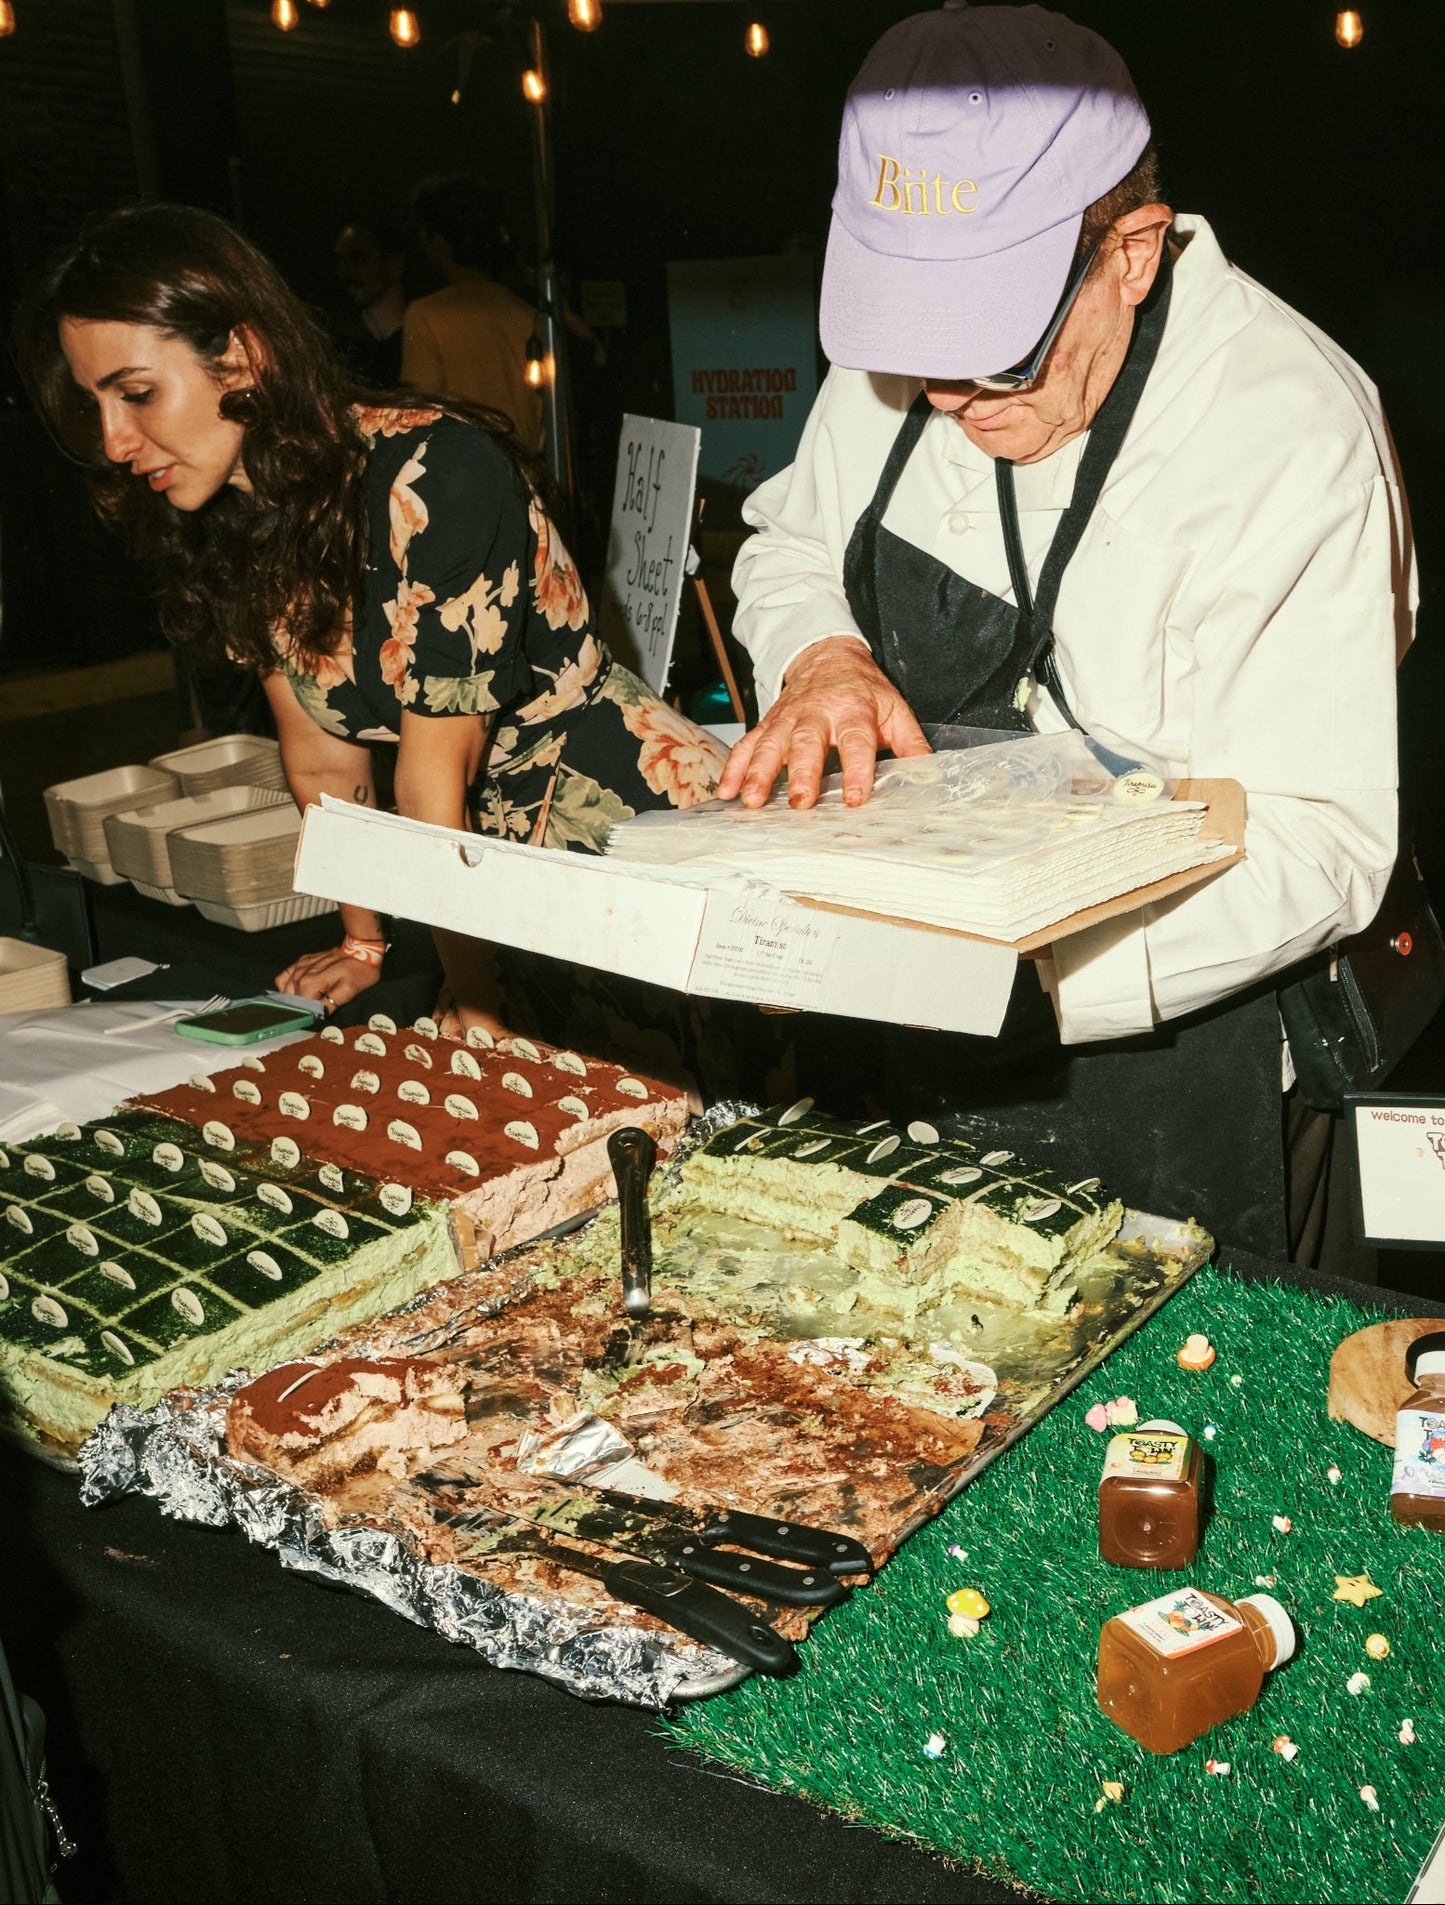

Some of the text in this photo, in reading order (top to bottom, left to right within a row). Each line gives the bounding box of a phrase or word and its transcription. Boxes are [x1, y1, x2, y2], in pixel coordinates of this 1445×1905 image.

[692, 368, 797, 395] HYDRATION
[706, 395, 785, 420] STATION
[622, 441, 665, 533] Half
[627, 531, 673, 596] Sheet
[1370, 1111, 1445, 1126] welcome to
[1128, 1438, 1178, 1447] TOASTY
[1185, 1593, 1229, 1626] TOASTY
